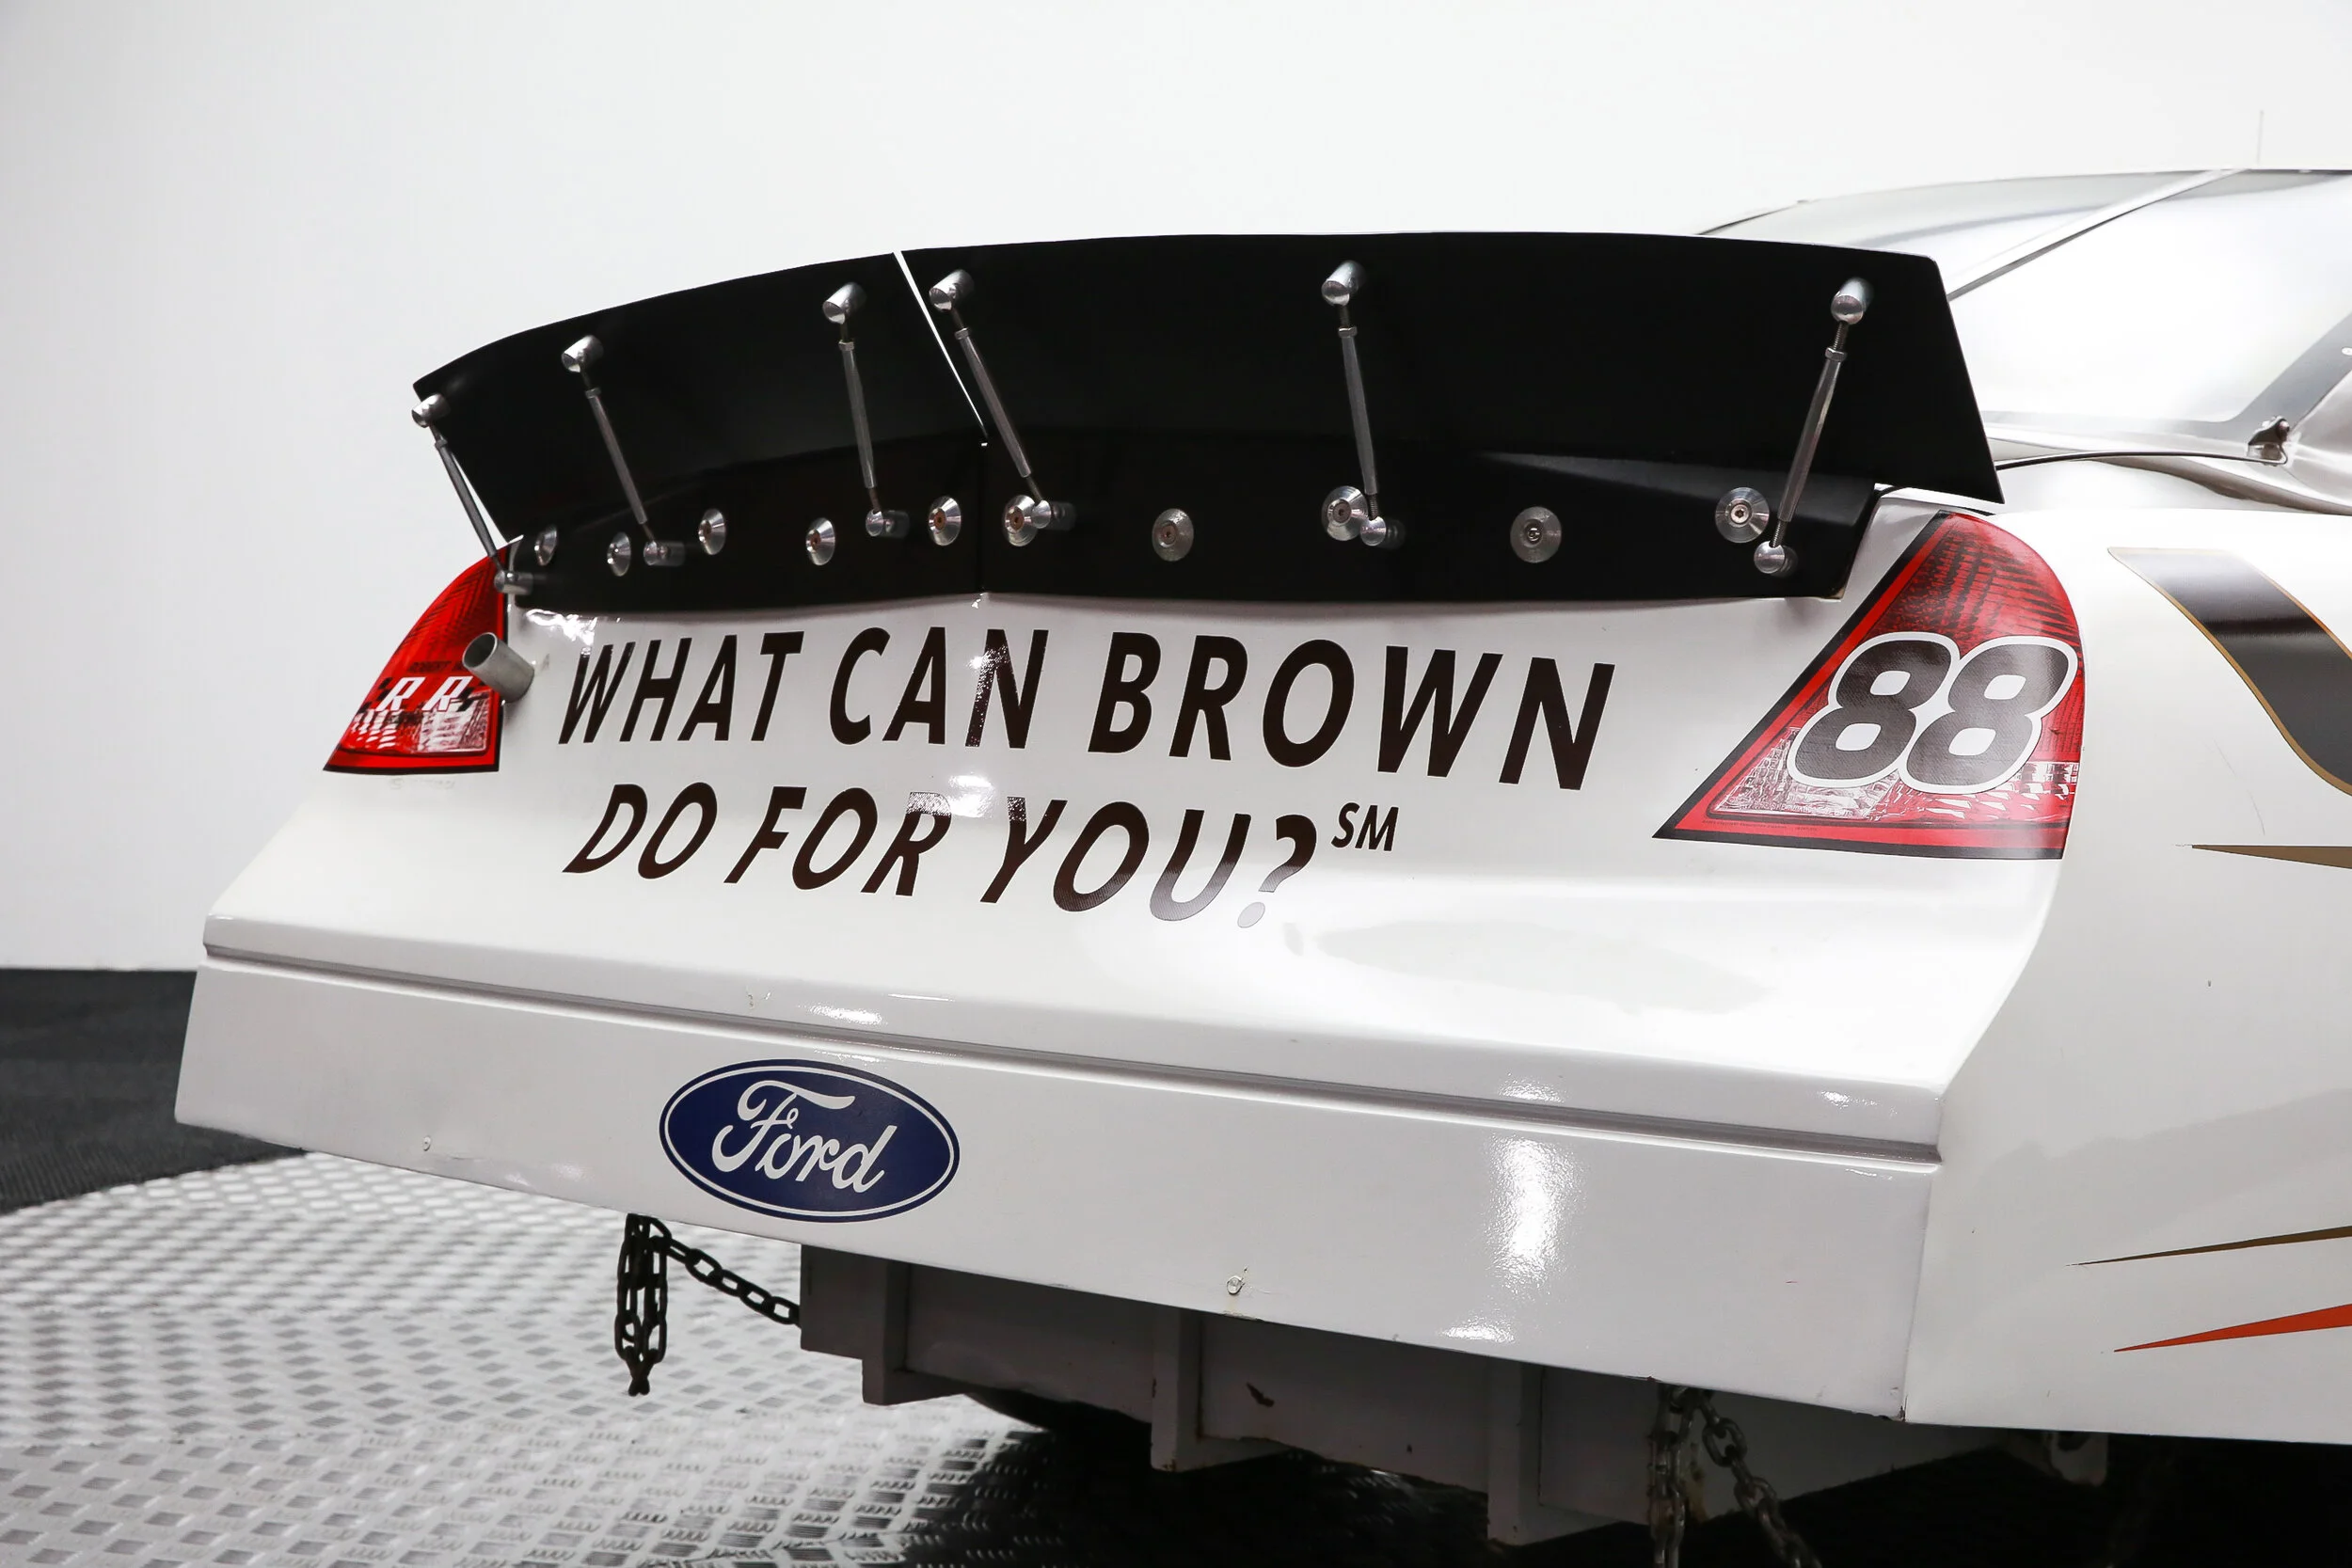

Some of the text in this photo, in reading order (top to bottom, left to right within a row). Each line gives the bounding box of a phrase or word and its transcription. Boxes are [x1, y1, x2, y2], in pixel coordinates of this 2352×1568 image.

[558, 626, 1616, 791] WHAT CAN BROWN
[1789, 633, 2076, 792] 88
[562, 782, 1399, 928] DO FOR YOU? SM
[711, 1080, 898, 1194] Ford
